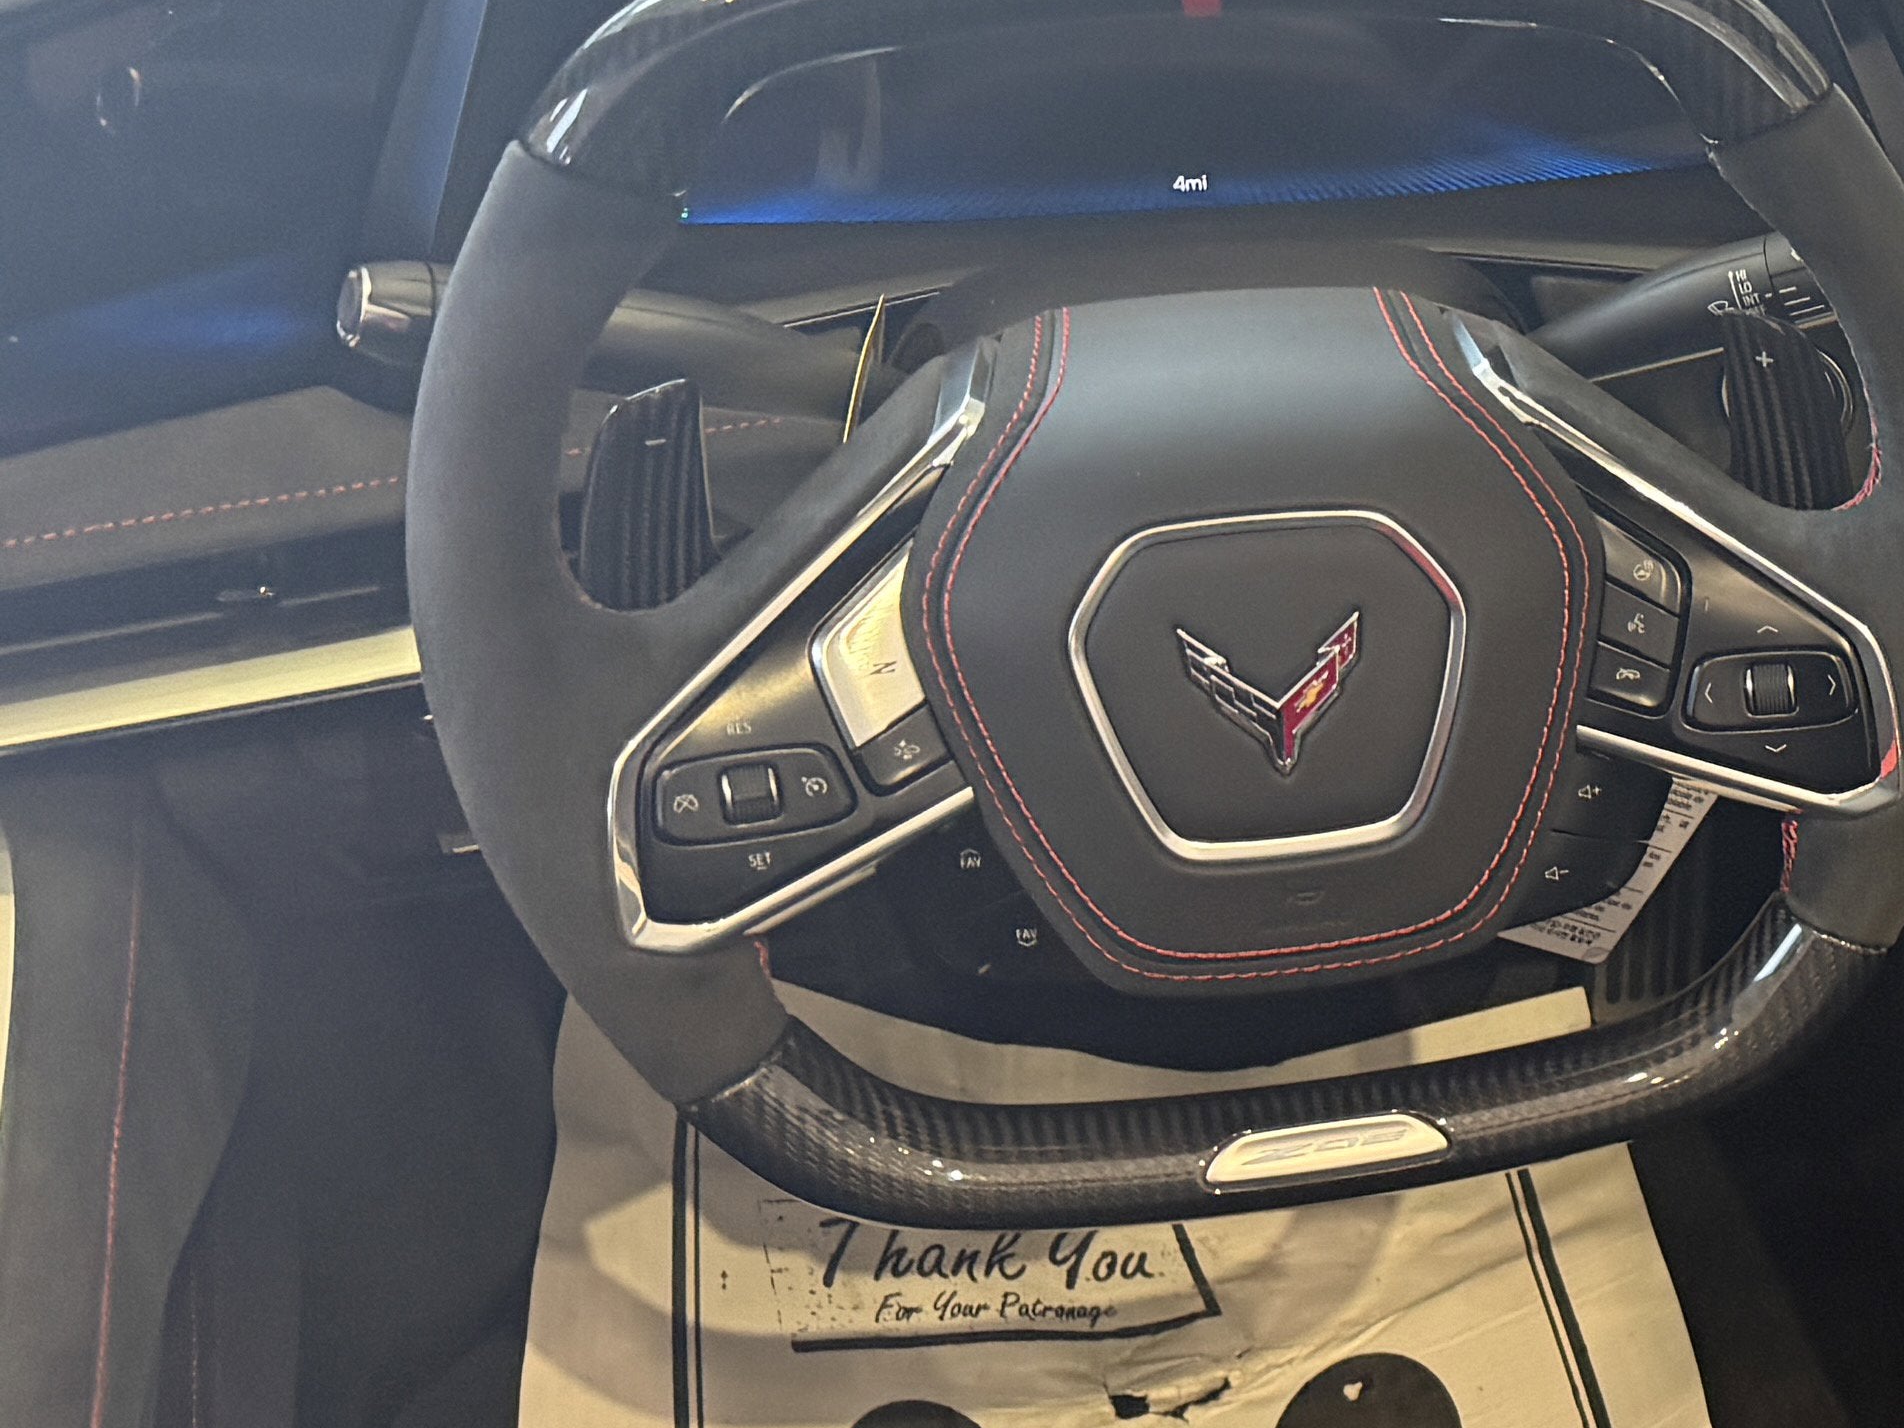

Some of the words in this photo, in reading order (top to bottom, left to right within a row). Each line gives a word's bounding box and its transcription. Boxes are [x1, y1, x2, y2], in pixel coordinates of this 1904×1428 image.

[1173, 174, 1208, 192] 4mi
[1738, 281, 1752, 295] LO
[726, 722, 752, 736] RES
[748, 851, 771, 868] SET
[960, 856, 981, 869] FAV
[1016, 928, 1037, 940] FAV
[1241, 1129, 1407, 1166] Z06
[819, 1217, 1027, 1289] Thank
[1048, 1229, 1155, 1290] You
[875, 1292, 921, 1323] For
[933, 1290, 990, 1322] Your
[997, 1291, 1119, 1327] Patronage
